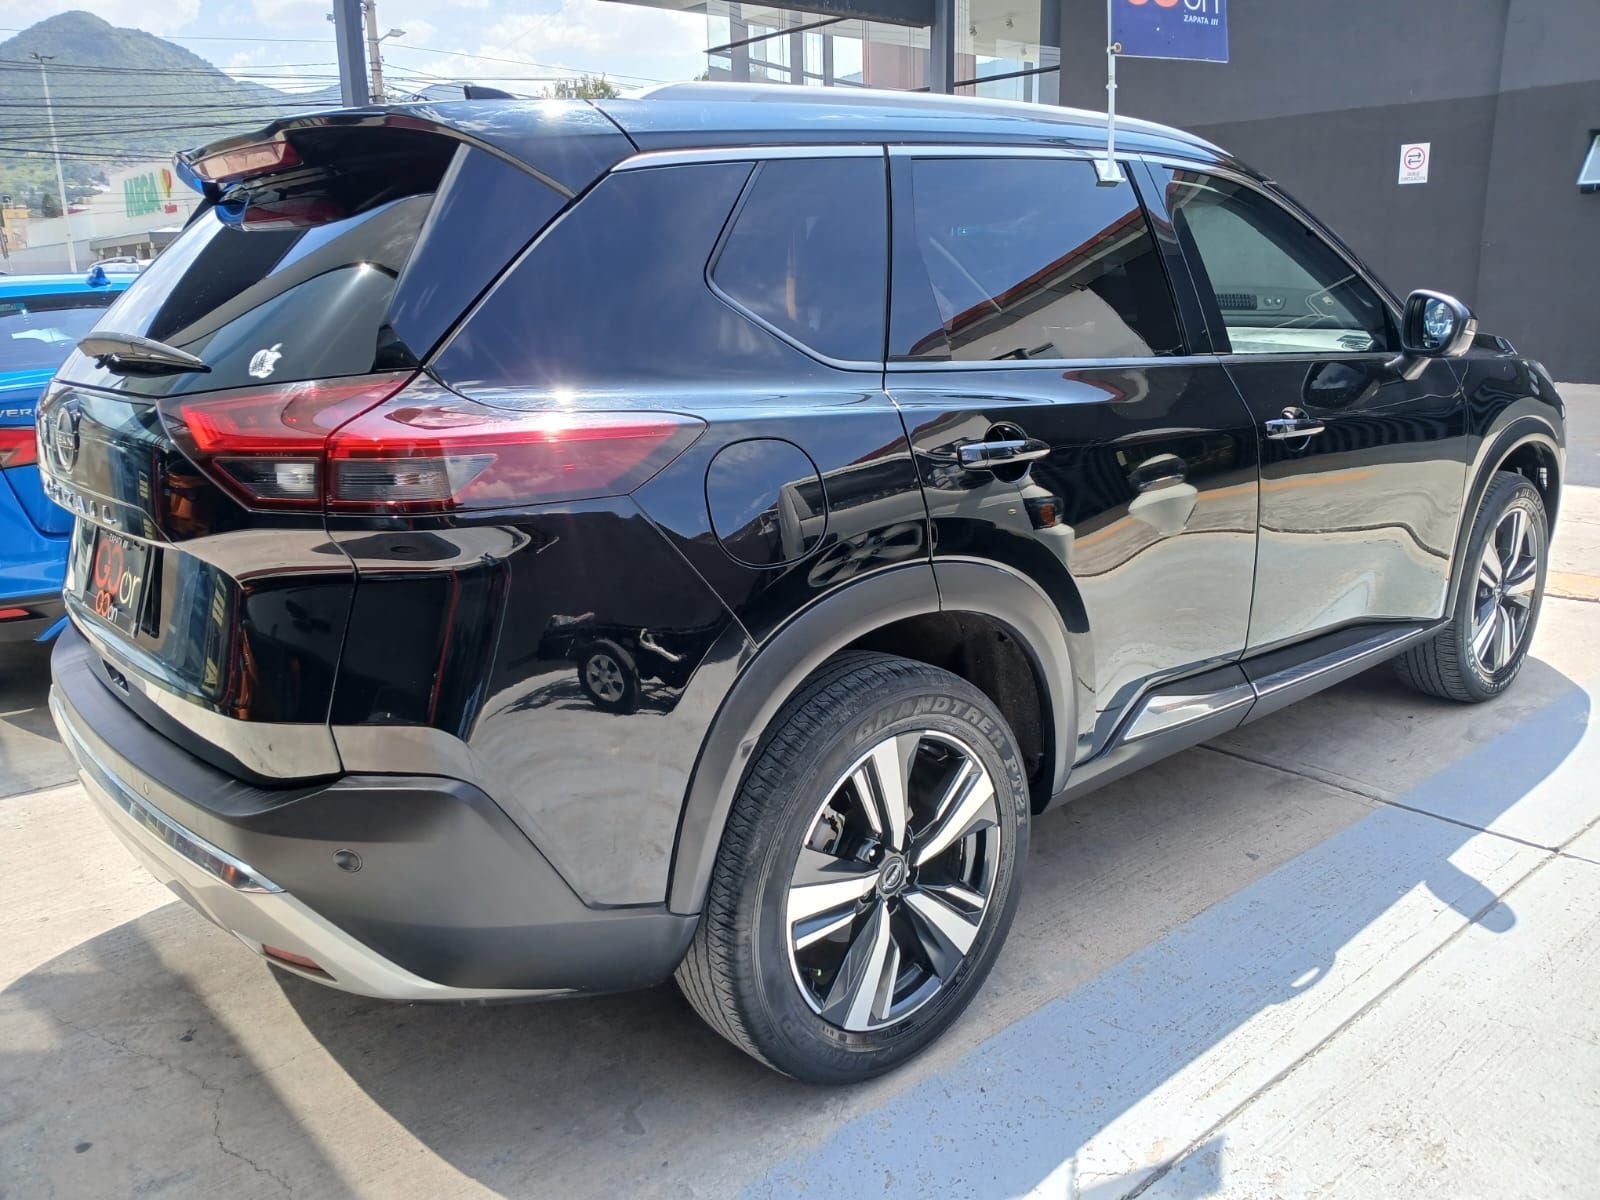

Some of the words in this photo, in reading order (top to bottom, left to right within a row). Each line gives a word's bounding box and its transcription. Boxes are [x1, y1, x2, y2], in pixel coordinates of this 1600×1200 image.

[1183, 14, 1209, 25] ZAPATA
[123, 172, 162, 218] MEGA
[855, 694, 1007, 749] GRANDTREK
